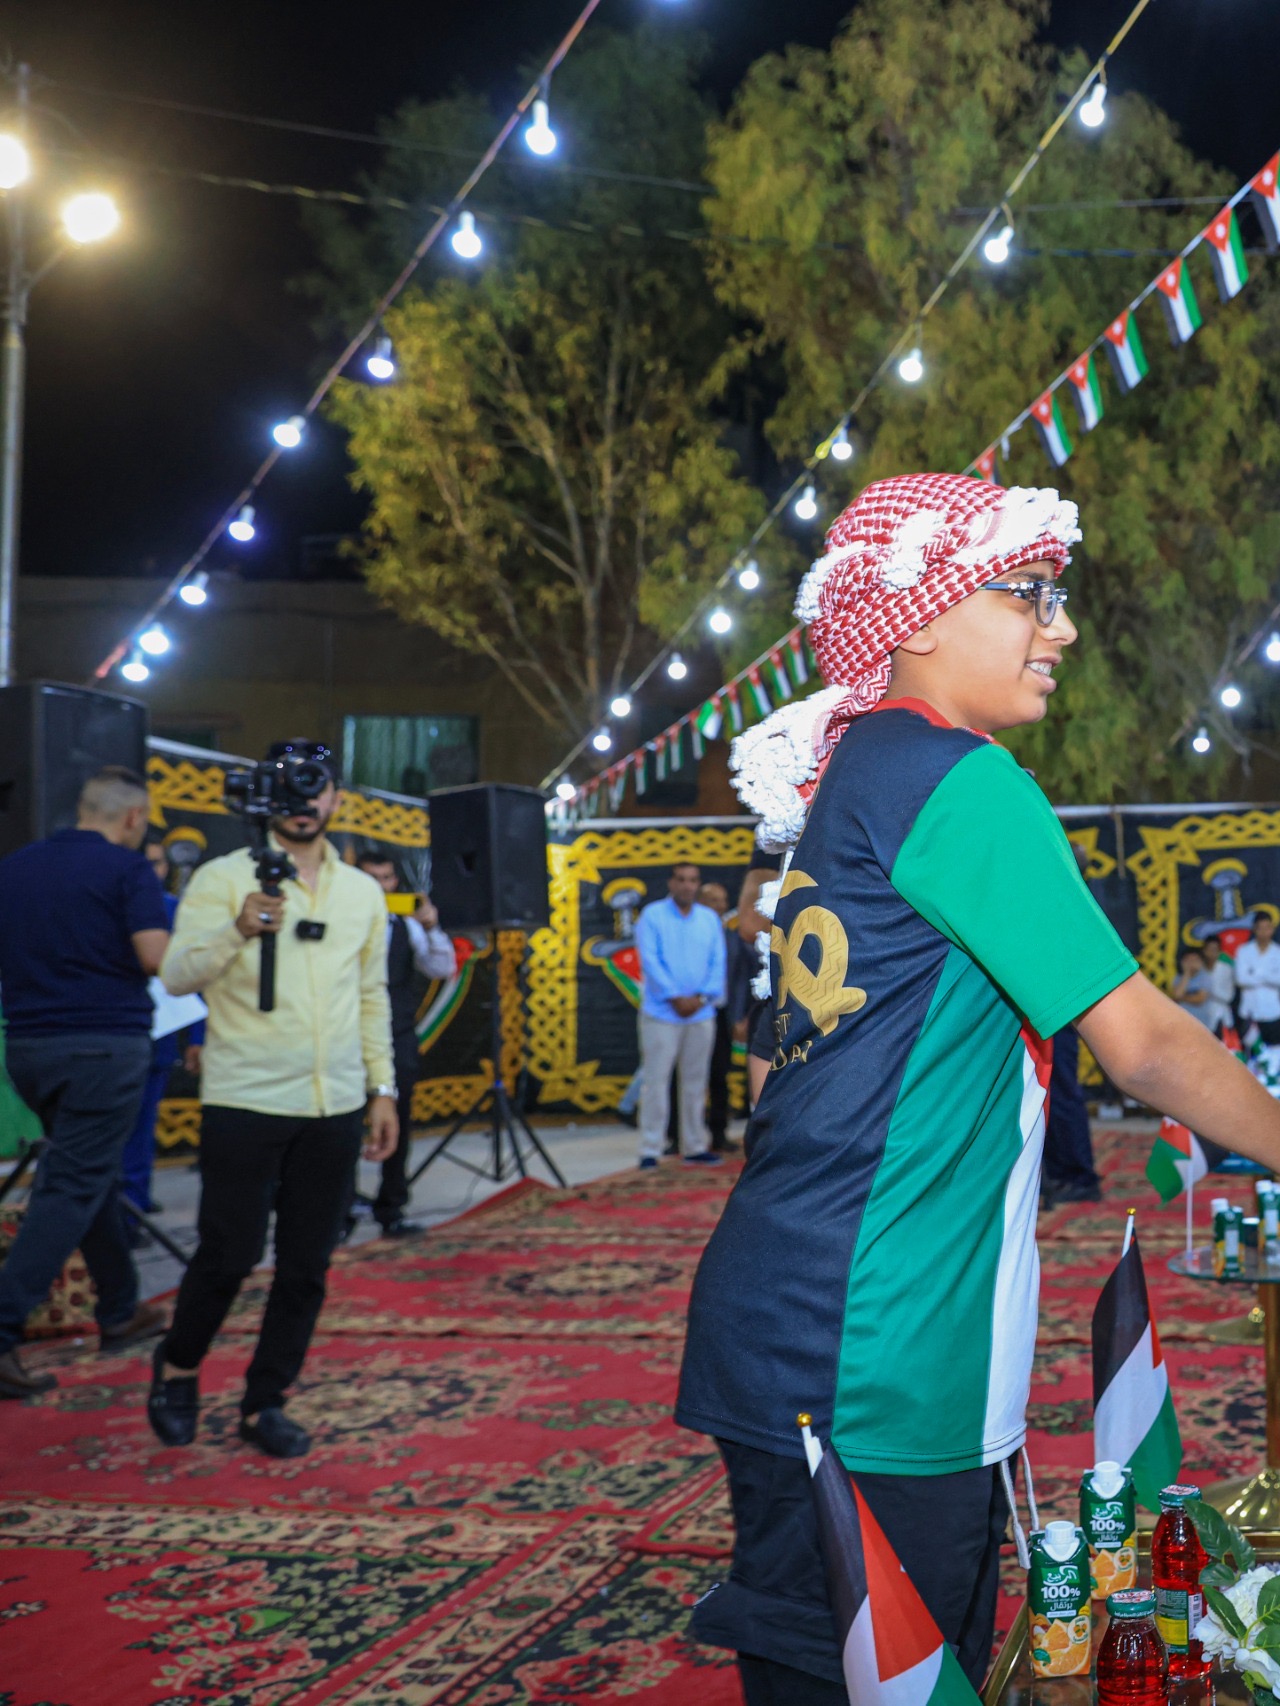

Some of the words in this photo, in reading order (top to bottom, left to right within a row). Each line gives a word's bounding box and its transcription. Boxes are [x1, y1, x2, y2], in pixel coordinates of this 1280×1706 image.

[1089, 1519, 1126, 1532] 100%
[1040, 1585, 1081, 1599] 100%
[1049, 1601, 1073, 1611] برتقال
